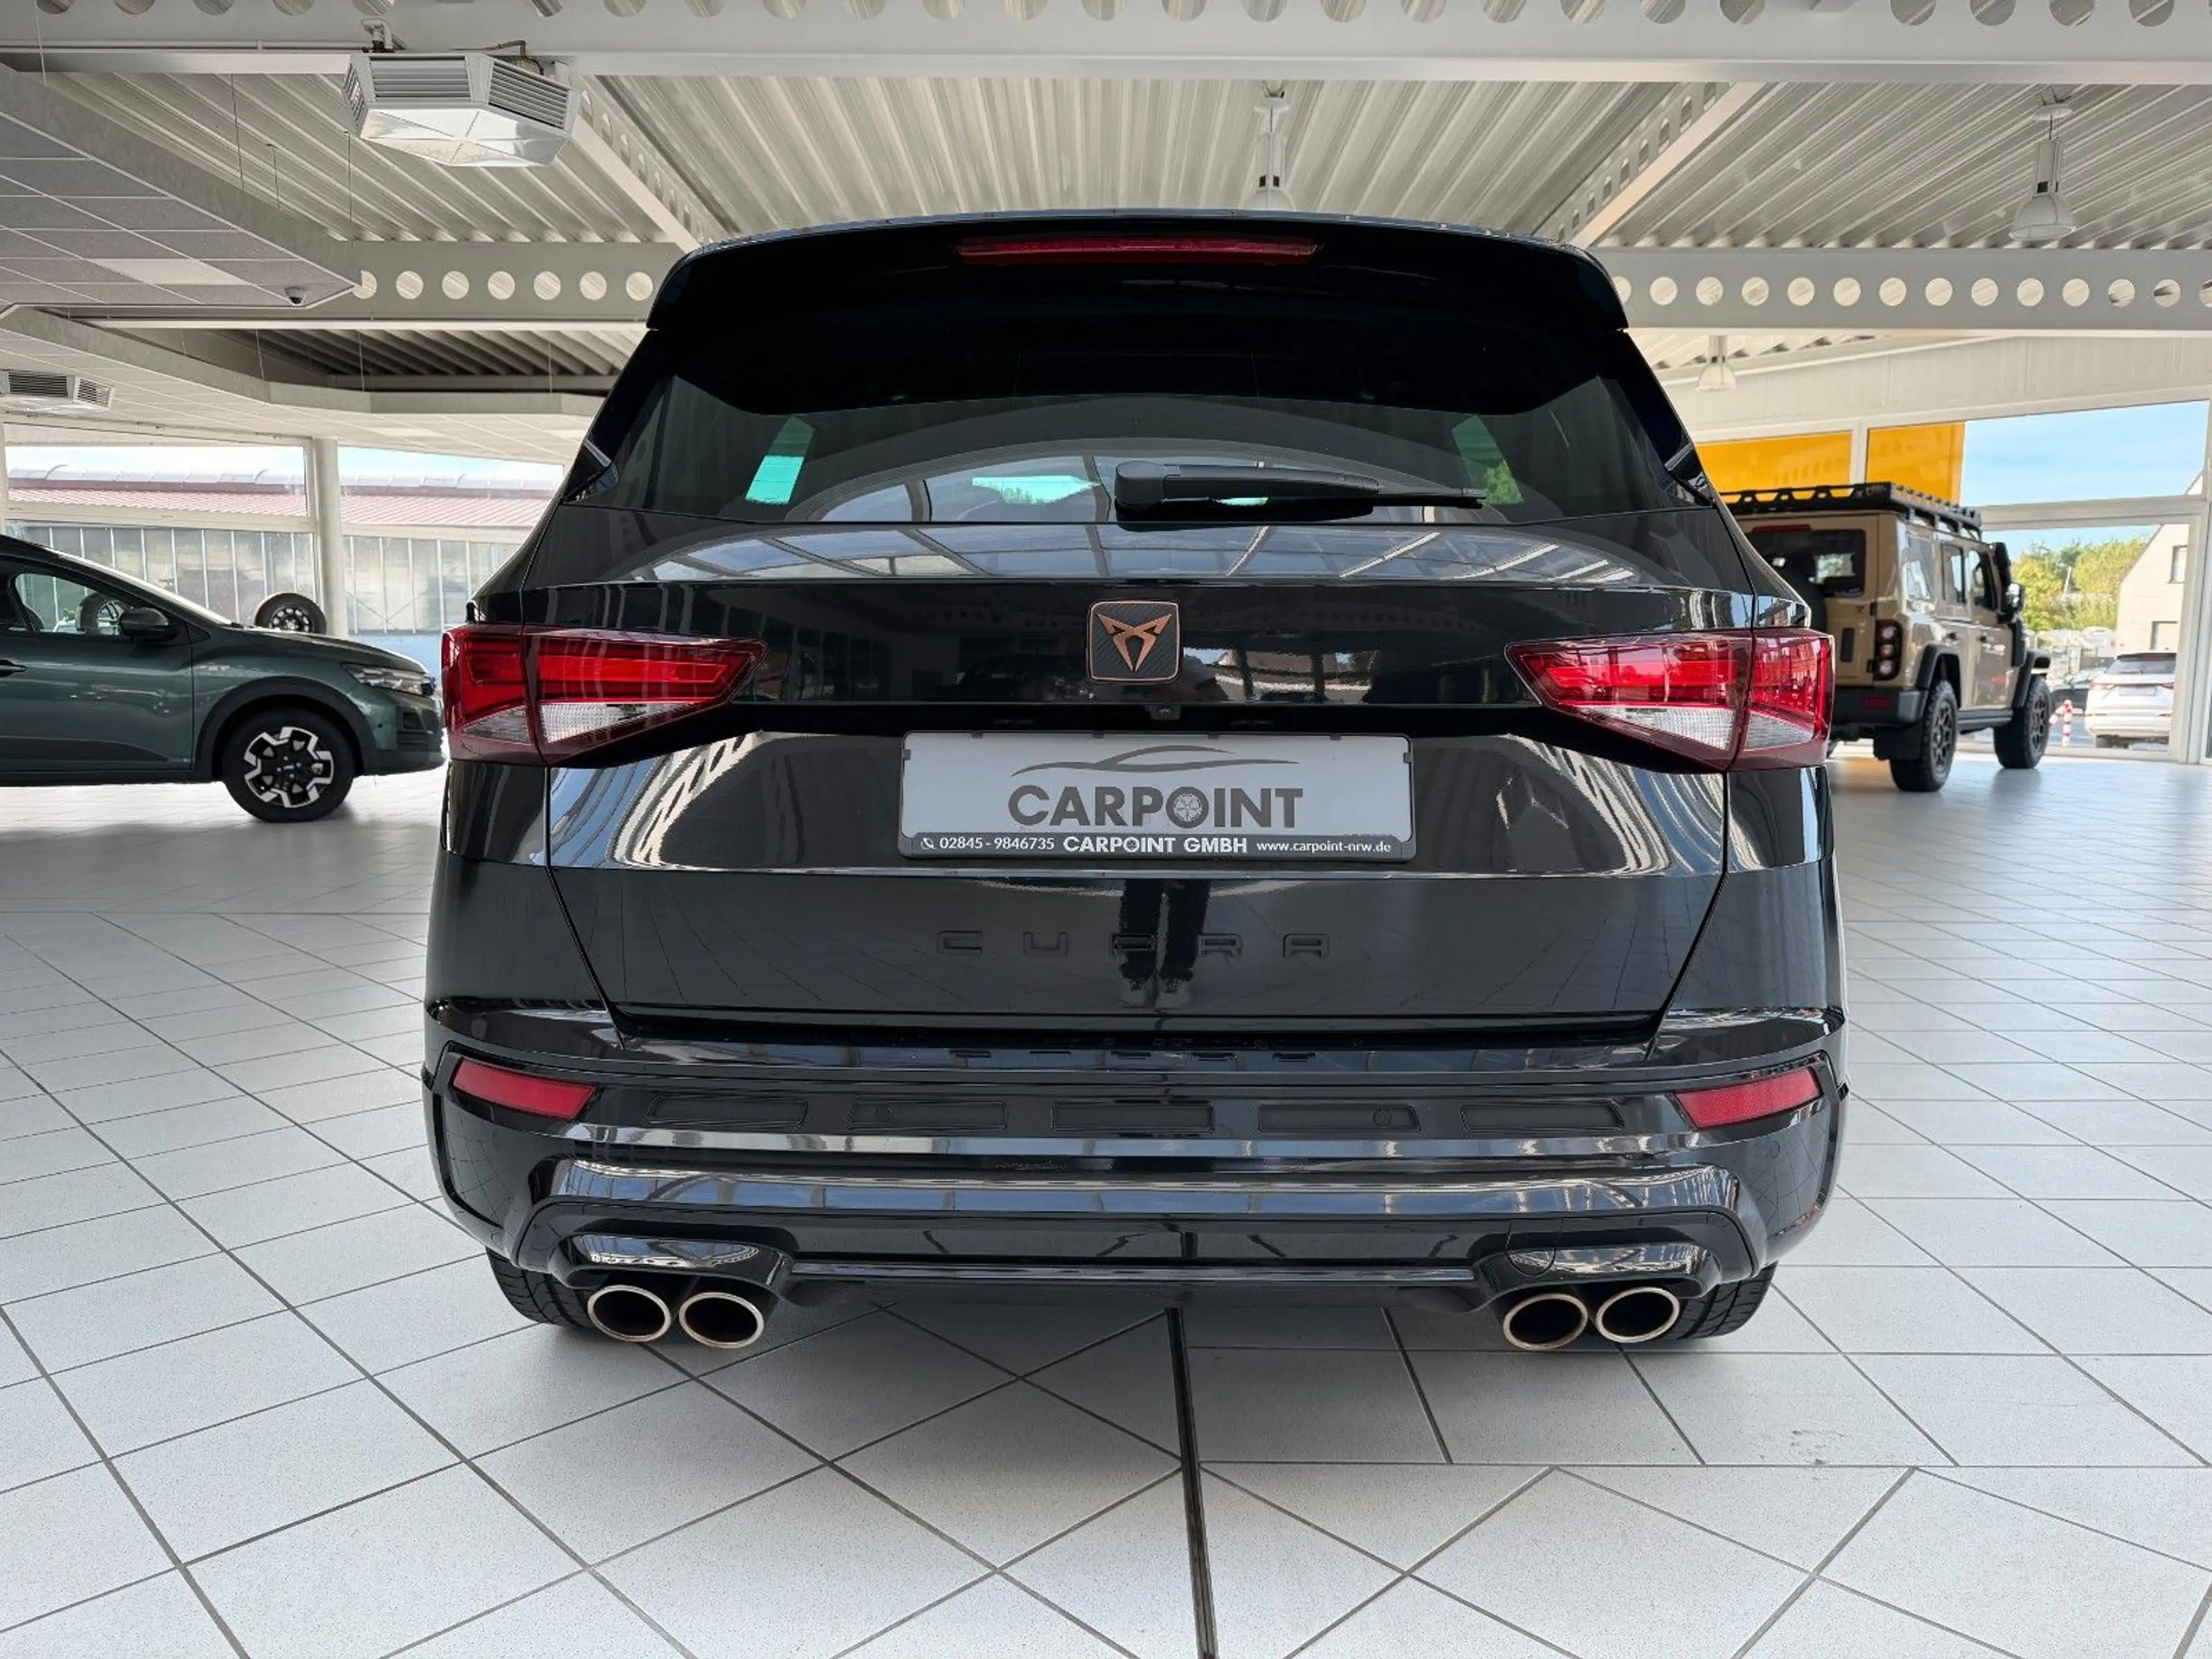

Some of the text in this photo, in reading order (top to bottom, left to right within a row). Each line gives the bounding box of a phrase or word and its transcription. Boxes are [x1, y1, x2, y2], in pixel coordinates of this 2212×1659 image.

[1009, 785, 1303, 828] CARPOINT
[940, 837, 983, 849] 02845
[994, 838, 1055, 850] 9846735
[1063, 836, 1176, 853] CARPOINT
[1184, 838, 1247, 853] GMBH
[1256, 840, 1391, 854] www.carpoint-nrw.de
[937, 930, 1329, 958] CUPRA
